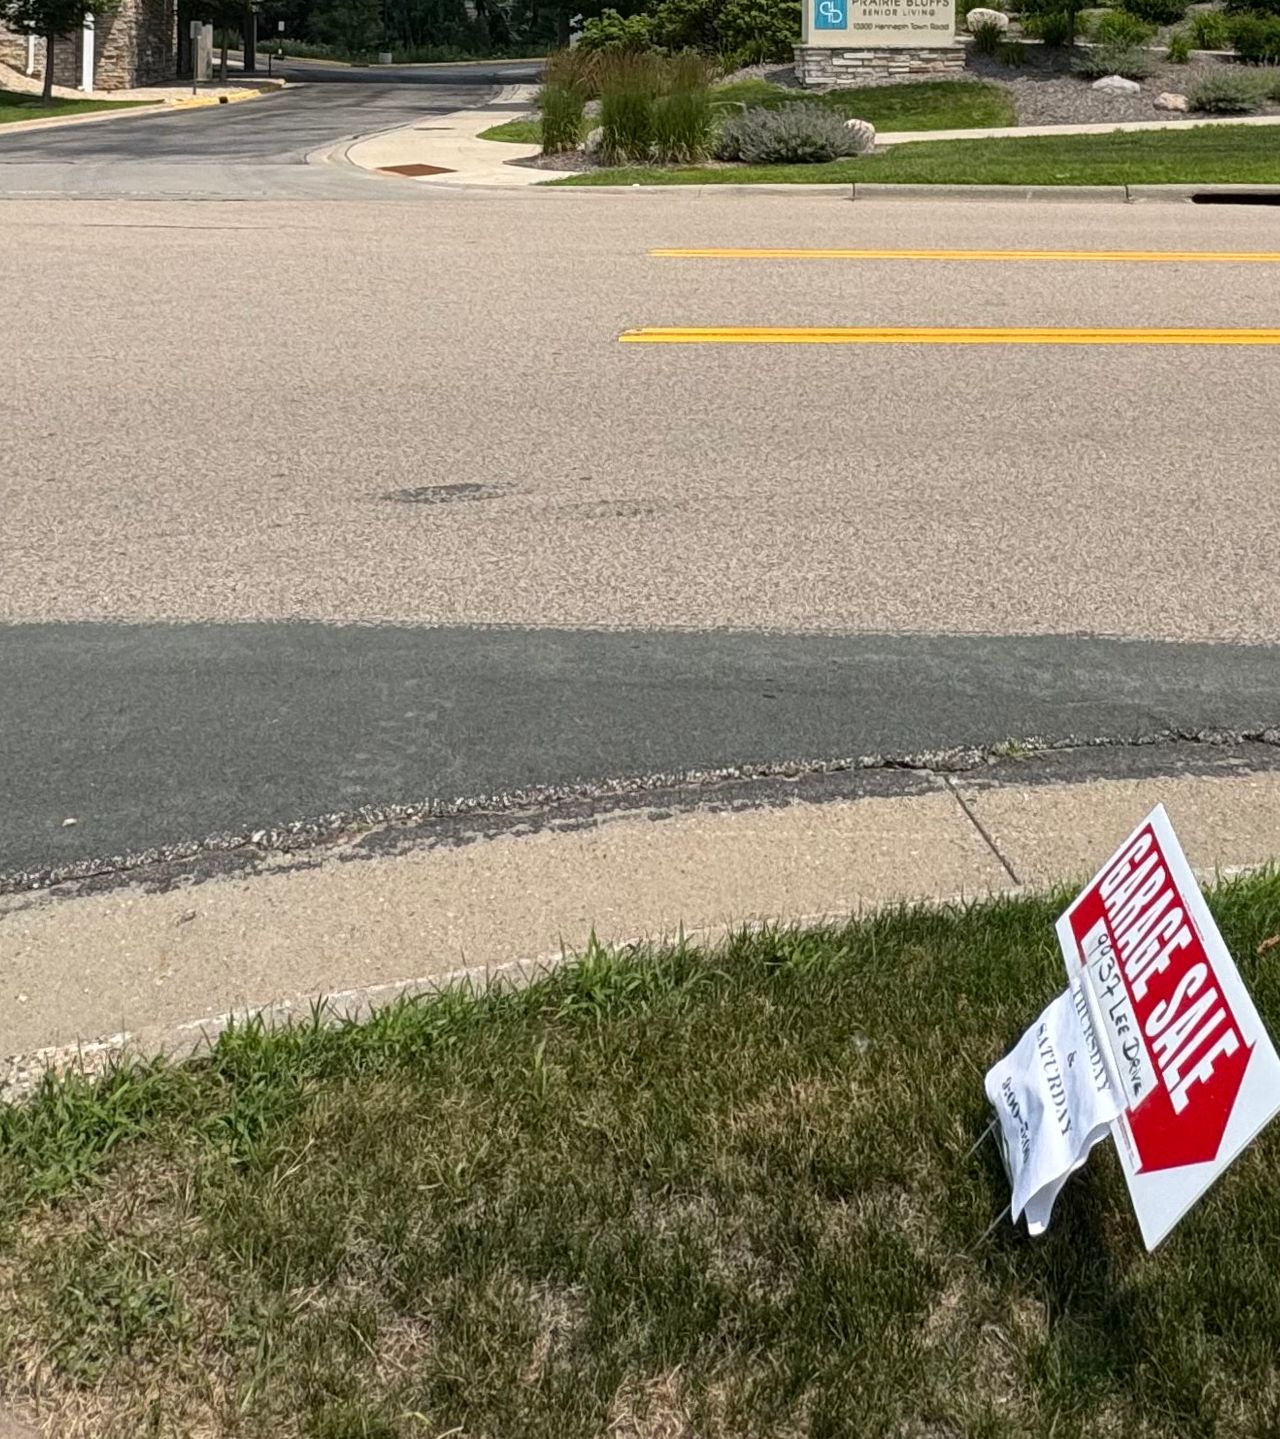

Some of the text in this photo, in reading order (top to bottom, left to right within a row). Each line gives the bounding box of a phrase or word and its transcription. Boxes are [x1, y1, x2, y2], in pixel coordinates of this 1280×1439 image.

[862, 8, 936, 17] SENIOR LIVING
[875, 22, 910, 31] Hennepin
[910, 22, 928, 31] Town
[930, 22, 950, 31] Road
[1087, 933, 1122, 999] 9937
[1108, 995, 1131, 1037] LEE
[1099, 833, 1240, 1116] GARAGE SALE
[1036, 1022, 1073, 1136] SATURDAY
[1066, 1049, 1078, 1069] &
[1072, 983, 1112, 1093] THURSDAY
